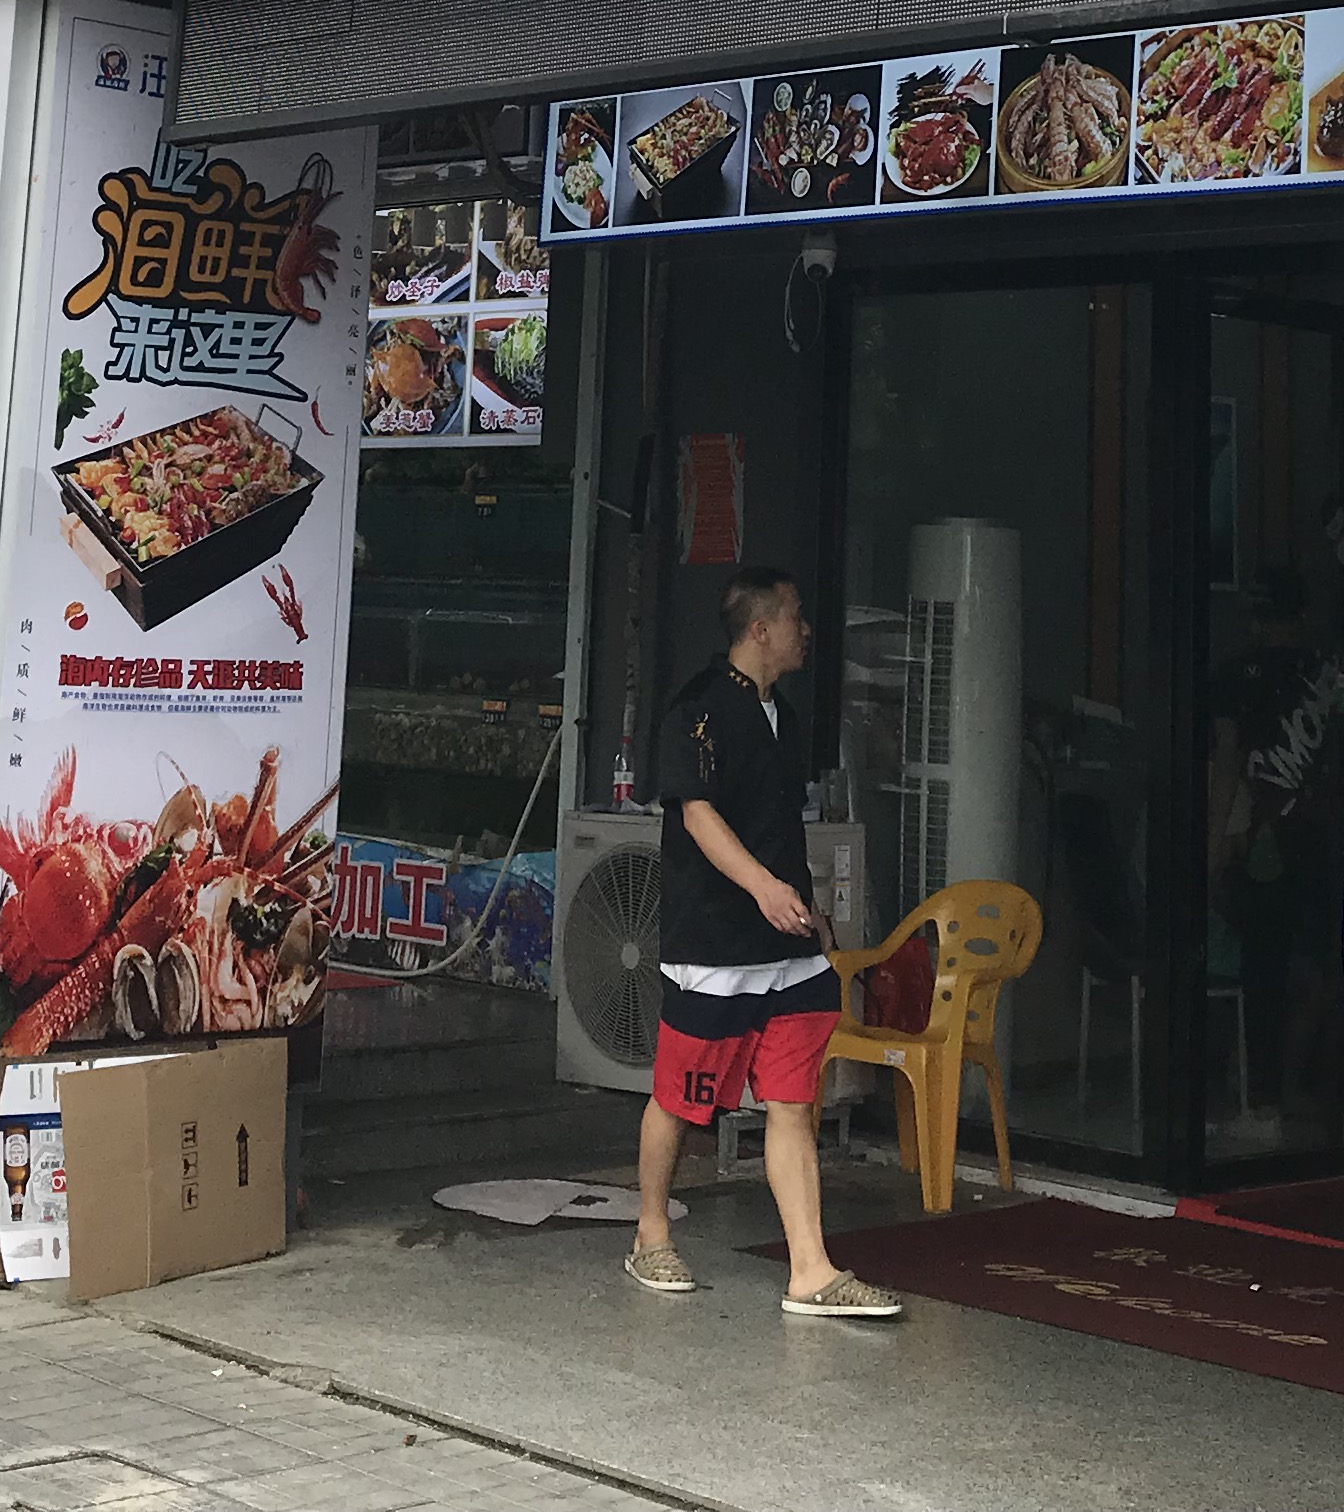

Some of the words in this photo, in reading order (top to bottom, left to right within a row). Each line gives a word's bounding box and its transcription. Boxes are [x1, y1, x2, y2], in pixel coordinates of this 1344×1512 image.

[479, 406, 544, 430] 清蒸石
[58, 654, 184, 689] 海内存珍品
[187, 658, 304, 691] 天涯共美味
[330, 842, 448, 947] 加工
[684, 1071, 717, 1105] 16
